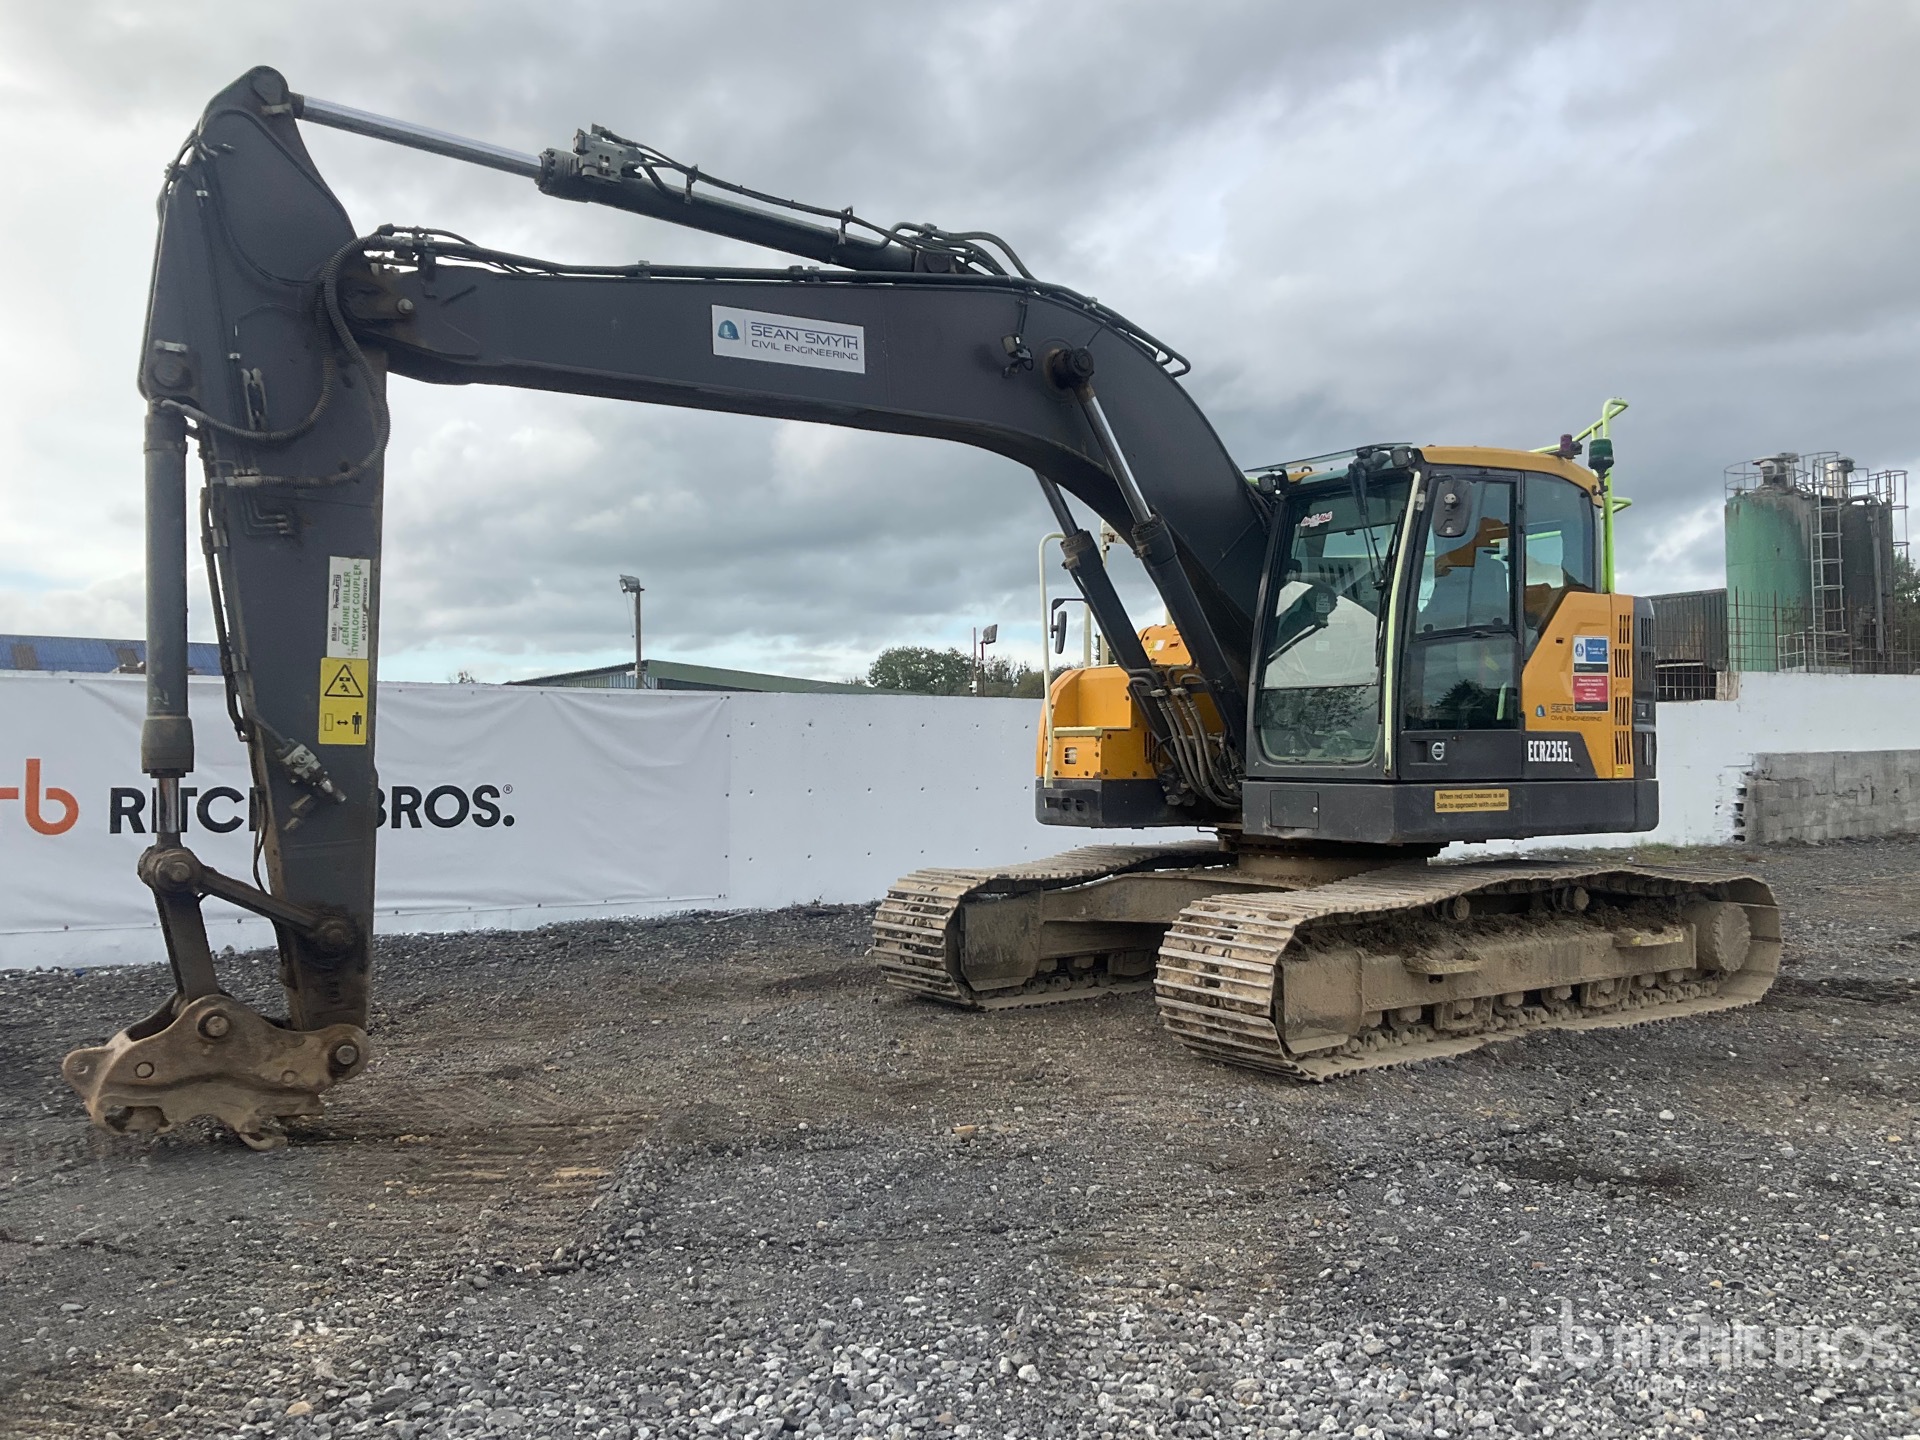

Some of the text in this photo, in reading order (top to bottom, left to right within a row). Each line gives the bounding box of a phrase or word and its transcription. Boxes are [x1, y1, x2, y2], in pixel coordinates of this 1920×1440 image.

[751, 325, 858, 350] SEAN SMYTH
[751, 339, 859, 361] CIVIL ENGINEERING
[342, 571, 351, 645] GENUINE MILLER
[351, 564, 361, 653] TWINLOCK COUPLER
[1527, 740, 1573, 762] ECR235EL
